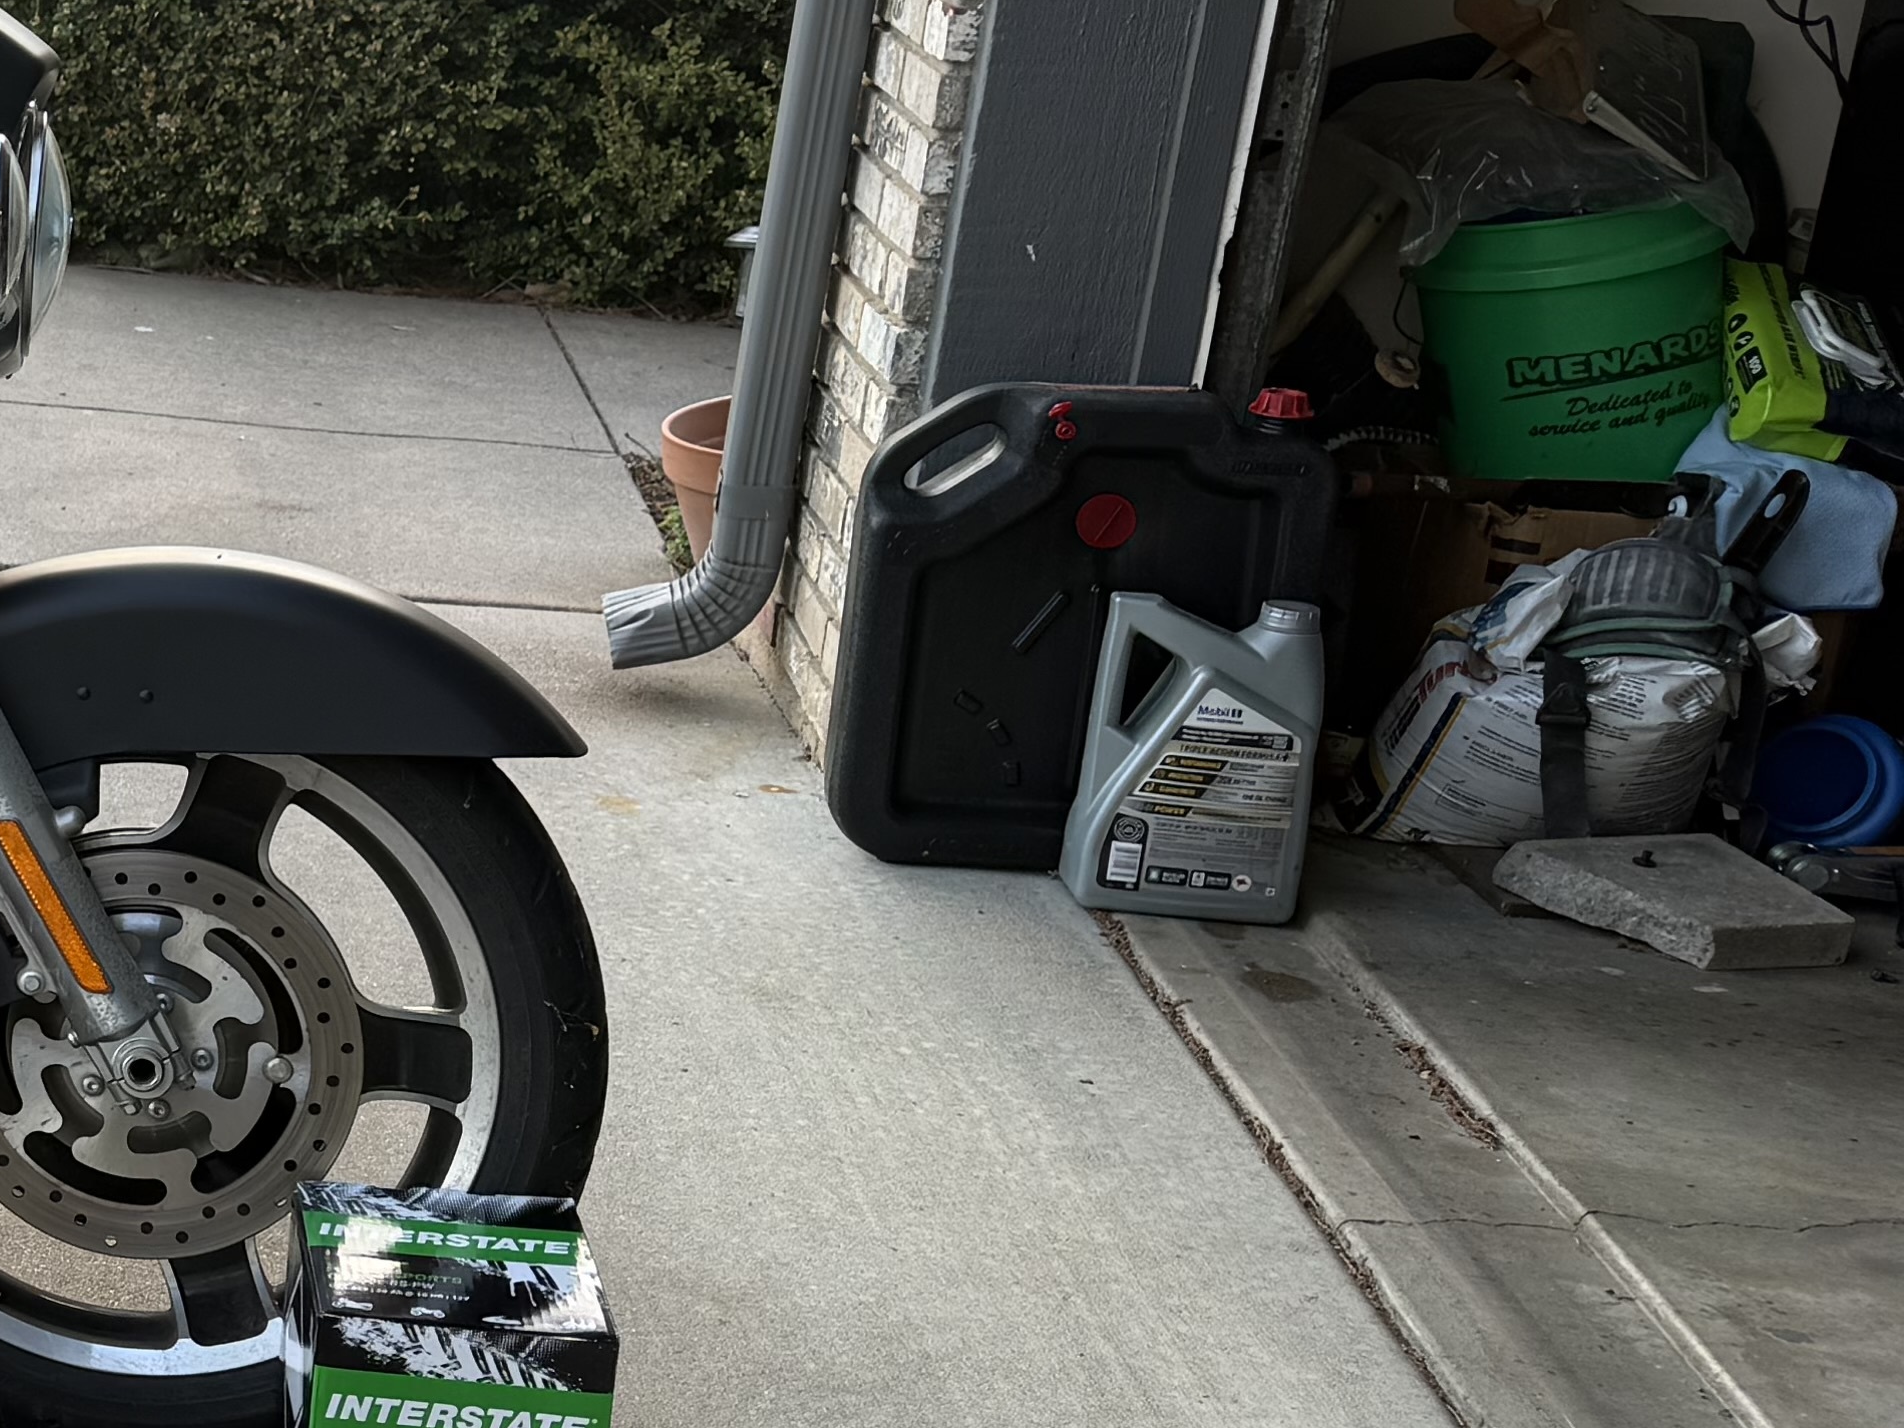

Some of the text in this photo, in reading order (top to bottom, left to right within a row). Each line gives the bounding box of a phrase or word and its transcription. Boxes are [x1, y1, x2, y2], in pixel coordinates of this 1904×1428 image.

[1506, 319, 1722, 388] MENARDS
[1529, 392, 1712, 437] service and quality
[1565, 379, 1694, 416] Dedicated to
[1197, 704, 1230, 717] Mobil
